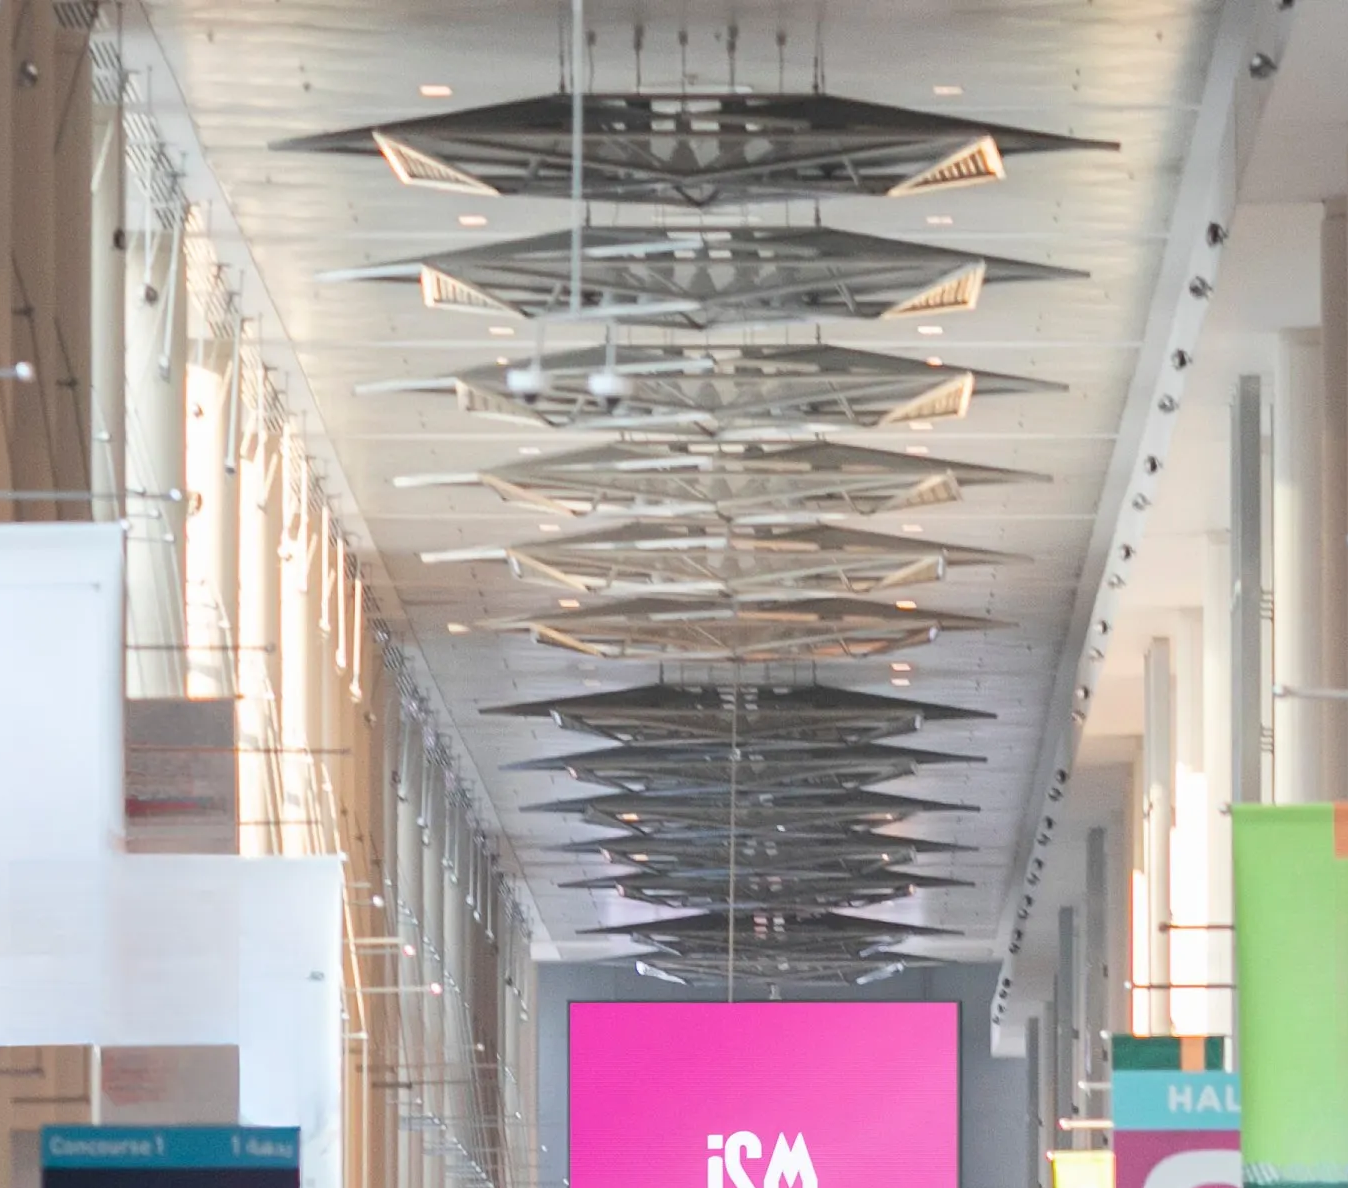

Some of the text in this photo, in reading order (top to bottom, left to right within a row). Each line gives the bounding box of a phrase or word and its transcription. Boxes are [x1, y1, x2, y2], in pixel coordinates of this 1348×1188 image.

[1168, 1084, 1241, 1113] HAL
[50, 1135, 165, 1156] Concourse 1
